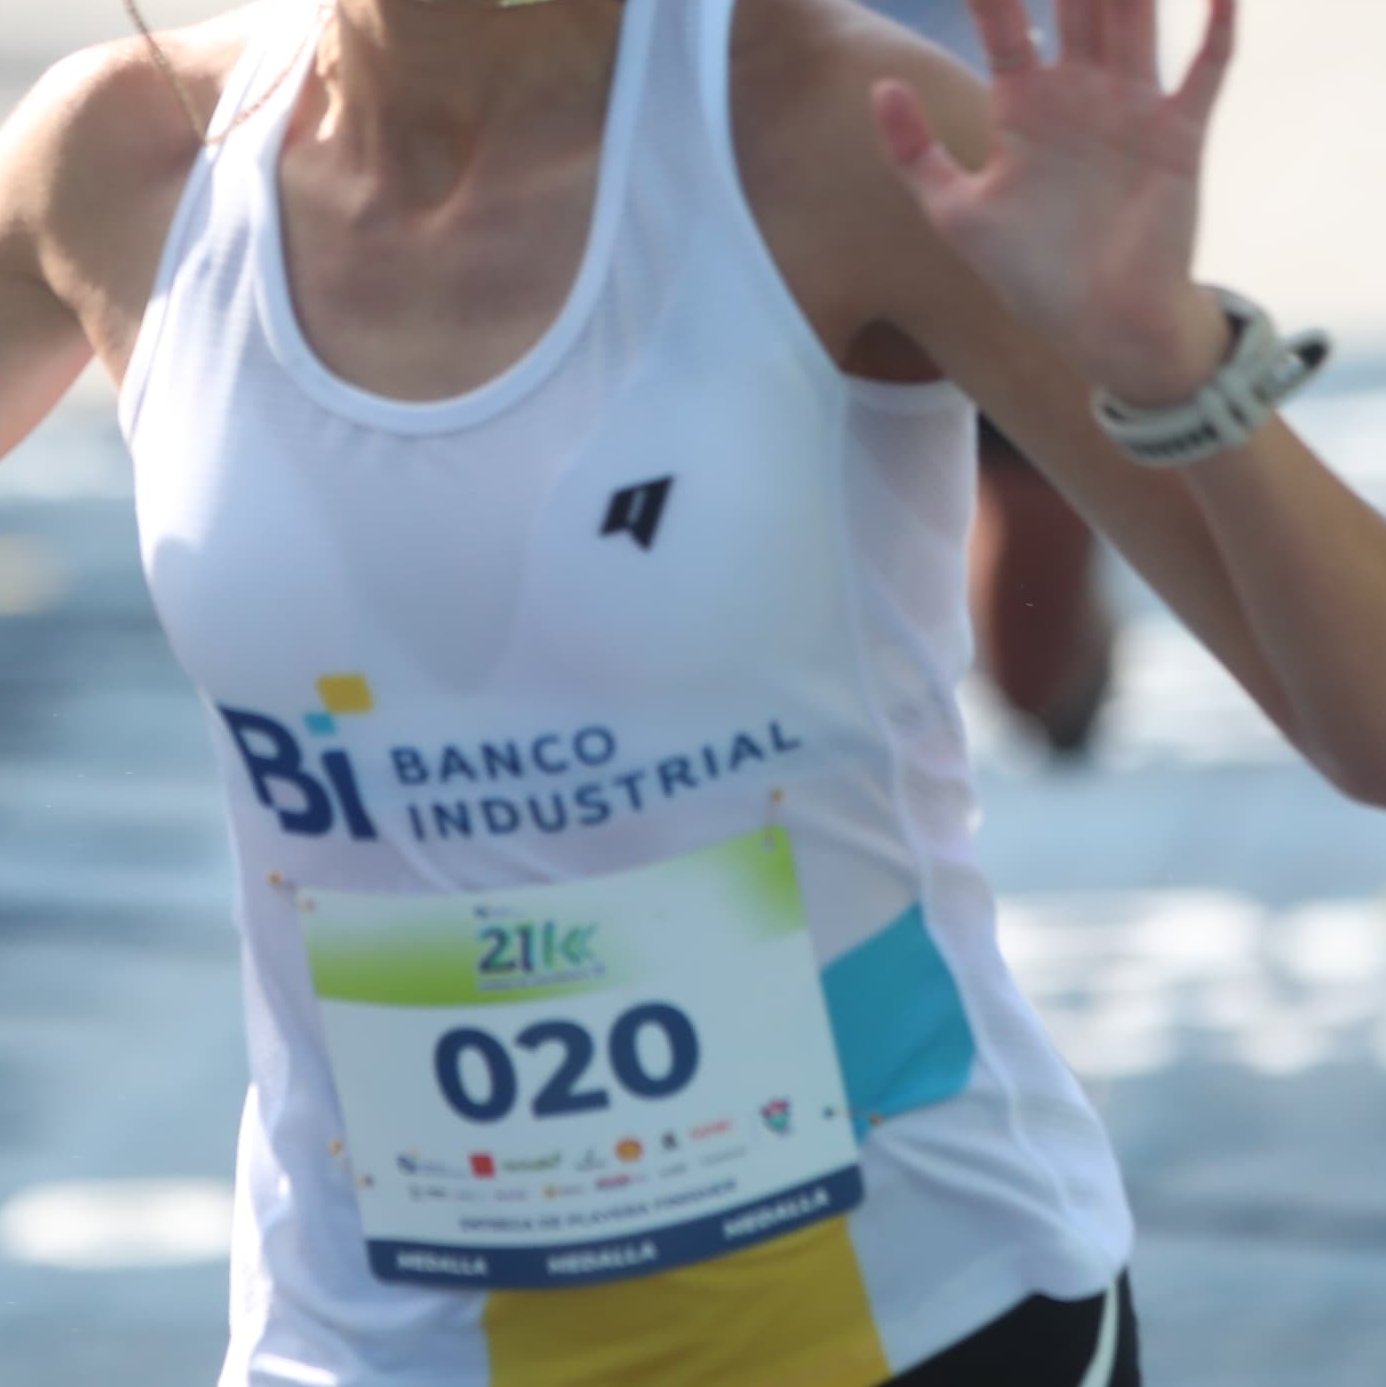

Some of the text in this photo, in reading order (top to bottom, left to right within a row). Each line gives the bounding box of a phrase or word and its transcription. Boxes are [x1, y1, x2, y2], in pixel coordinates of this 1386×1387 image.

[216, 699, 378, 841] Bi
[389, 724, 616, 787] BANCO
[406, 720, 802, 842] INDUSTRIAL
[433, 1000, 700, 1123] 020
[395, 1186, 831, 1277] MEDALLA MEDALLA MEDALLA
